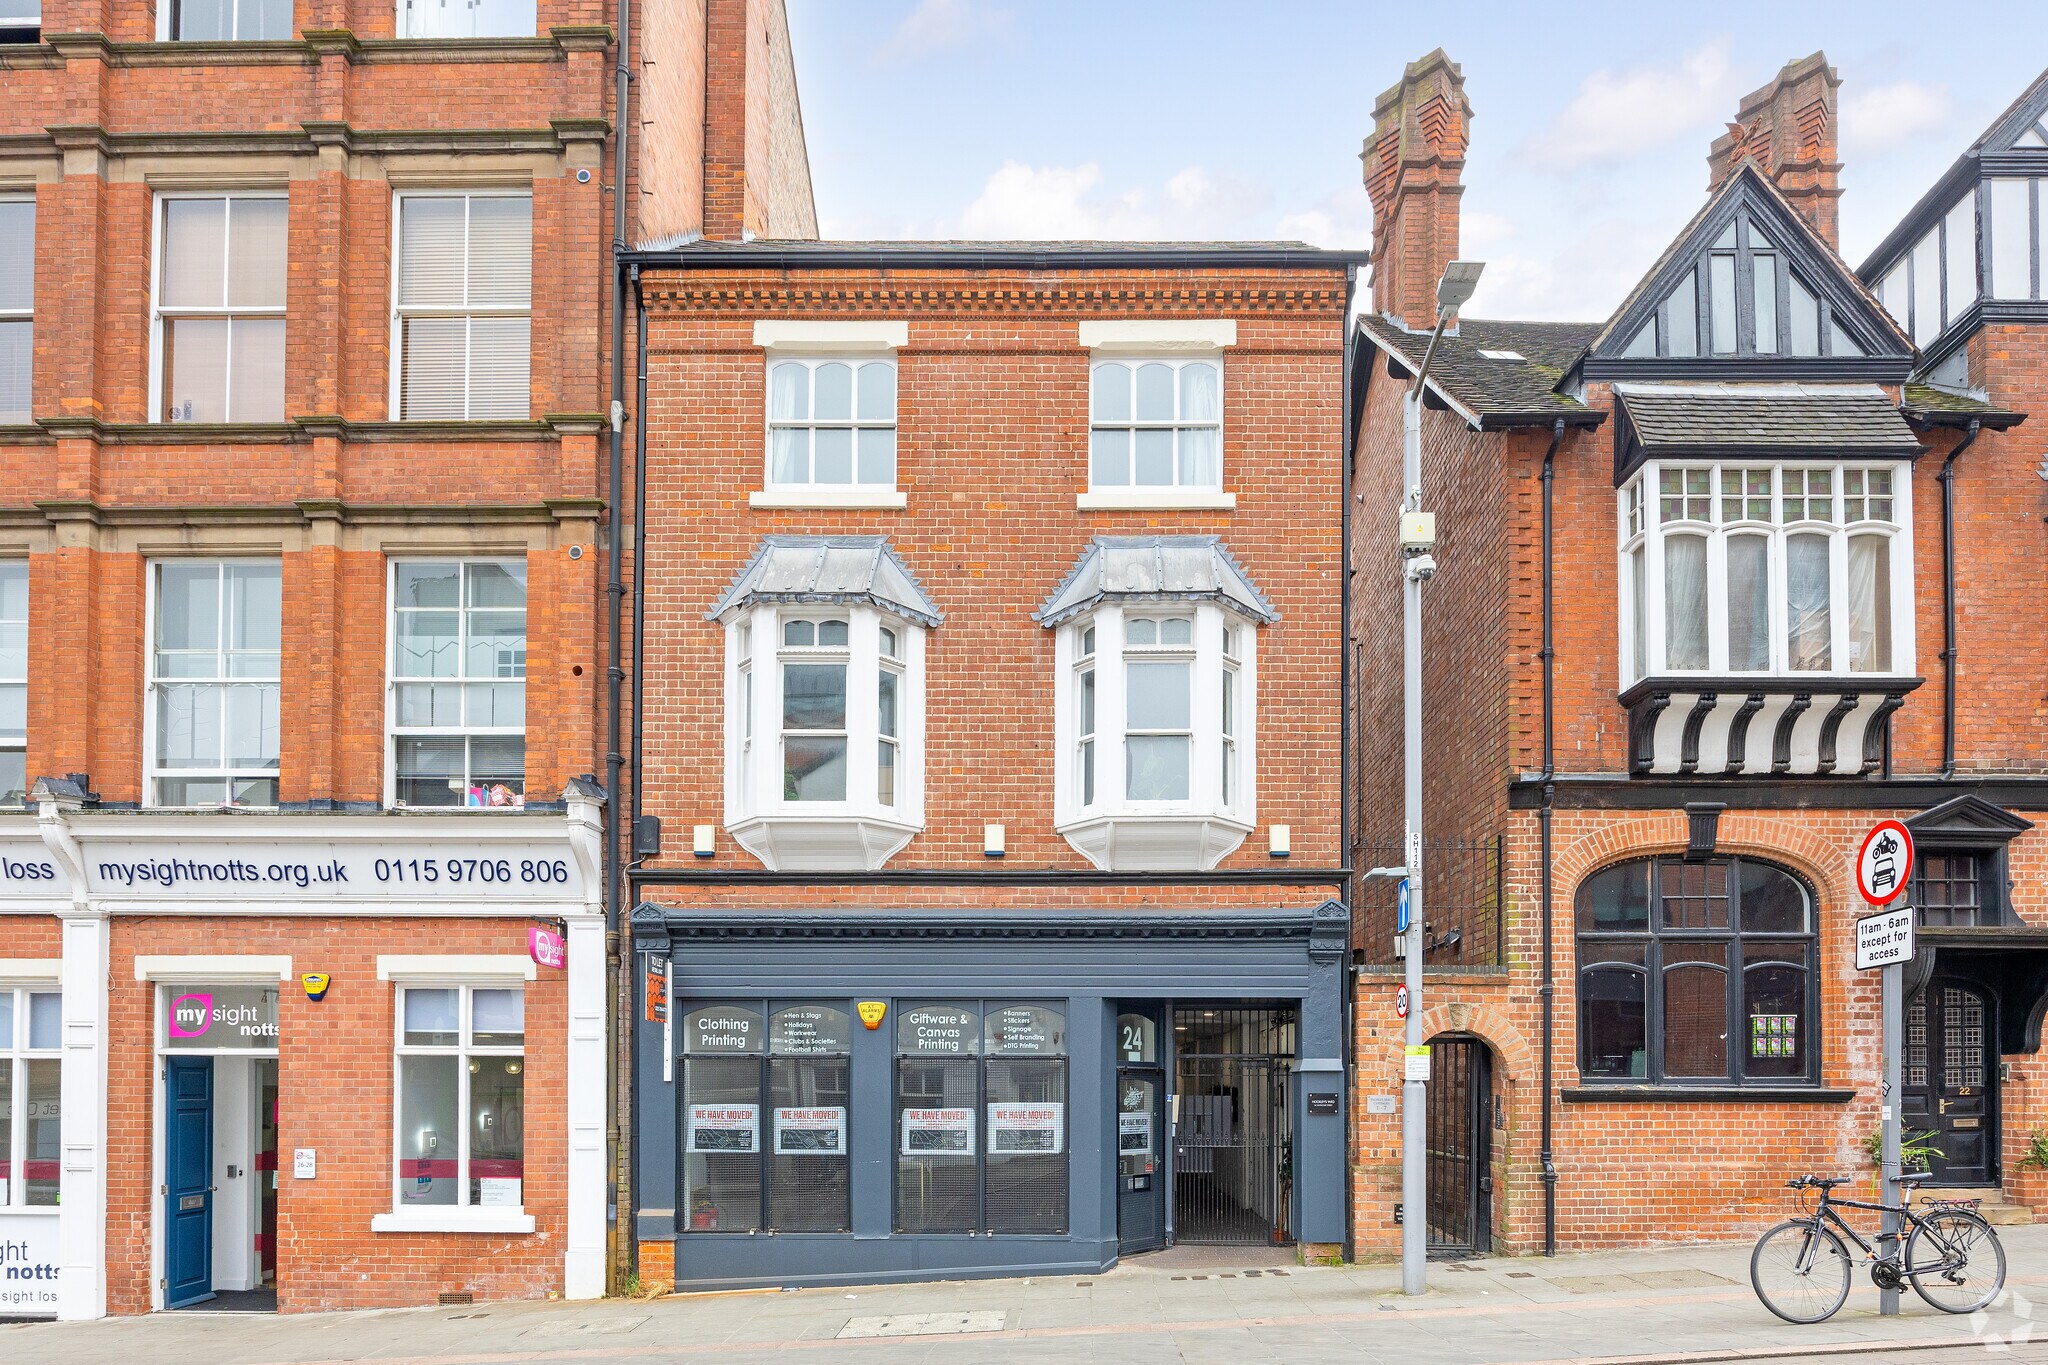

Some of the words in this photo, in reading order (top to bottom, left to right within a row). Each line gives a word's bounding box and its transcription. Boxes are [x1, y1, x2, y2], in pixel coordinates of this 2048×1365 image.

[2, 857, 55, 880] loss
[99, 858, 349, 887] mysightnotts.org.uk
[374, 859, 439, 882] 0115
[447, 859, 511, 882] 9706
[520, 859, 568, 883] 806
[1861, 923, 1882, 935] 11am
[1888, 917, 1909, 929] 6am
[1861, 933, 1891, 949] except
[1894, 931, 1907, 942] for
[550, 942, 564, 958] sight
[1869, 947, 1899, 961] access
[1397, 993, 1407, 1009] 20
[176, 1008, 207, 1026] my
[212, 1004, 258, 1026] sight
[806, 1012, 822, 1020] Stags
[909, 1013, 957, 1025] Giftware
[960, 1014, 968, 1025] &
[698, 1018, 749, 1032] Clothing
[917, 1026, 961, 1038] Canvas
[701, 1034, 746, 1048] Printing
[1019, 1034, 1045, 1042] Branding
[1122, 1025, 1143, 1050] 24
[918, 1038, 959, 1052] Printing
[1959, 1087, 1971, 1095] 22
[695, 1110, 706, 1119] WE
[707, 1110, 725, 1119] HAVE
[726, 1110, 753, 1120] MOVED!
[781, 1110, 792, 1119] WE
[793, 1110, 811, 1119] HAVE
[812, 1110, 839, 1119] MOVED!
[909, 1110, 920, 1120] WE
[922, 1110, 940, 1120] HAVE
[940, 1110, 967, 1120] MOVED!
[996, 1110, 1007, 1119] WE
[1008, 1110, 1026, 1119] HAVE
[1028, 1110, 1055, 1119] MOVED!
[2, 1291, 33, 1304] sight
